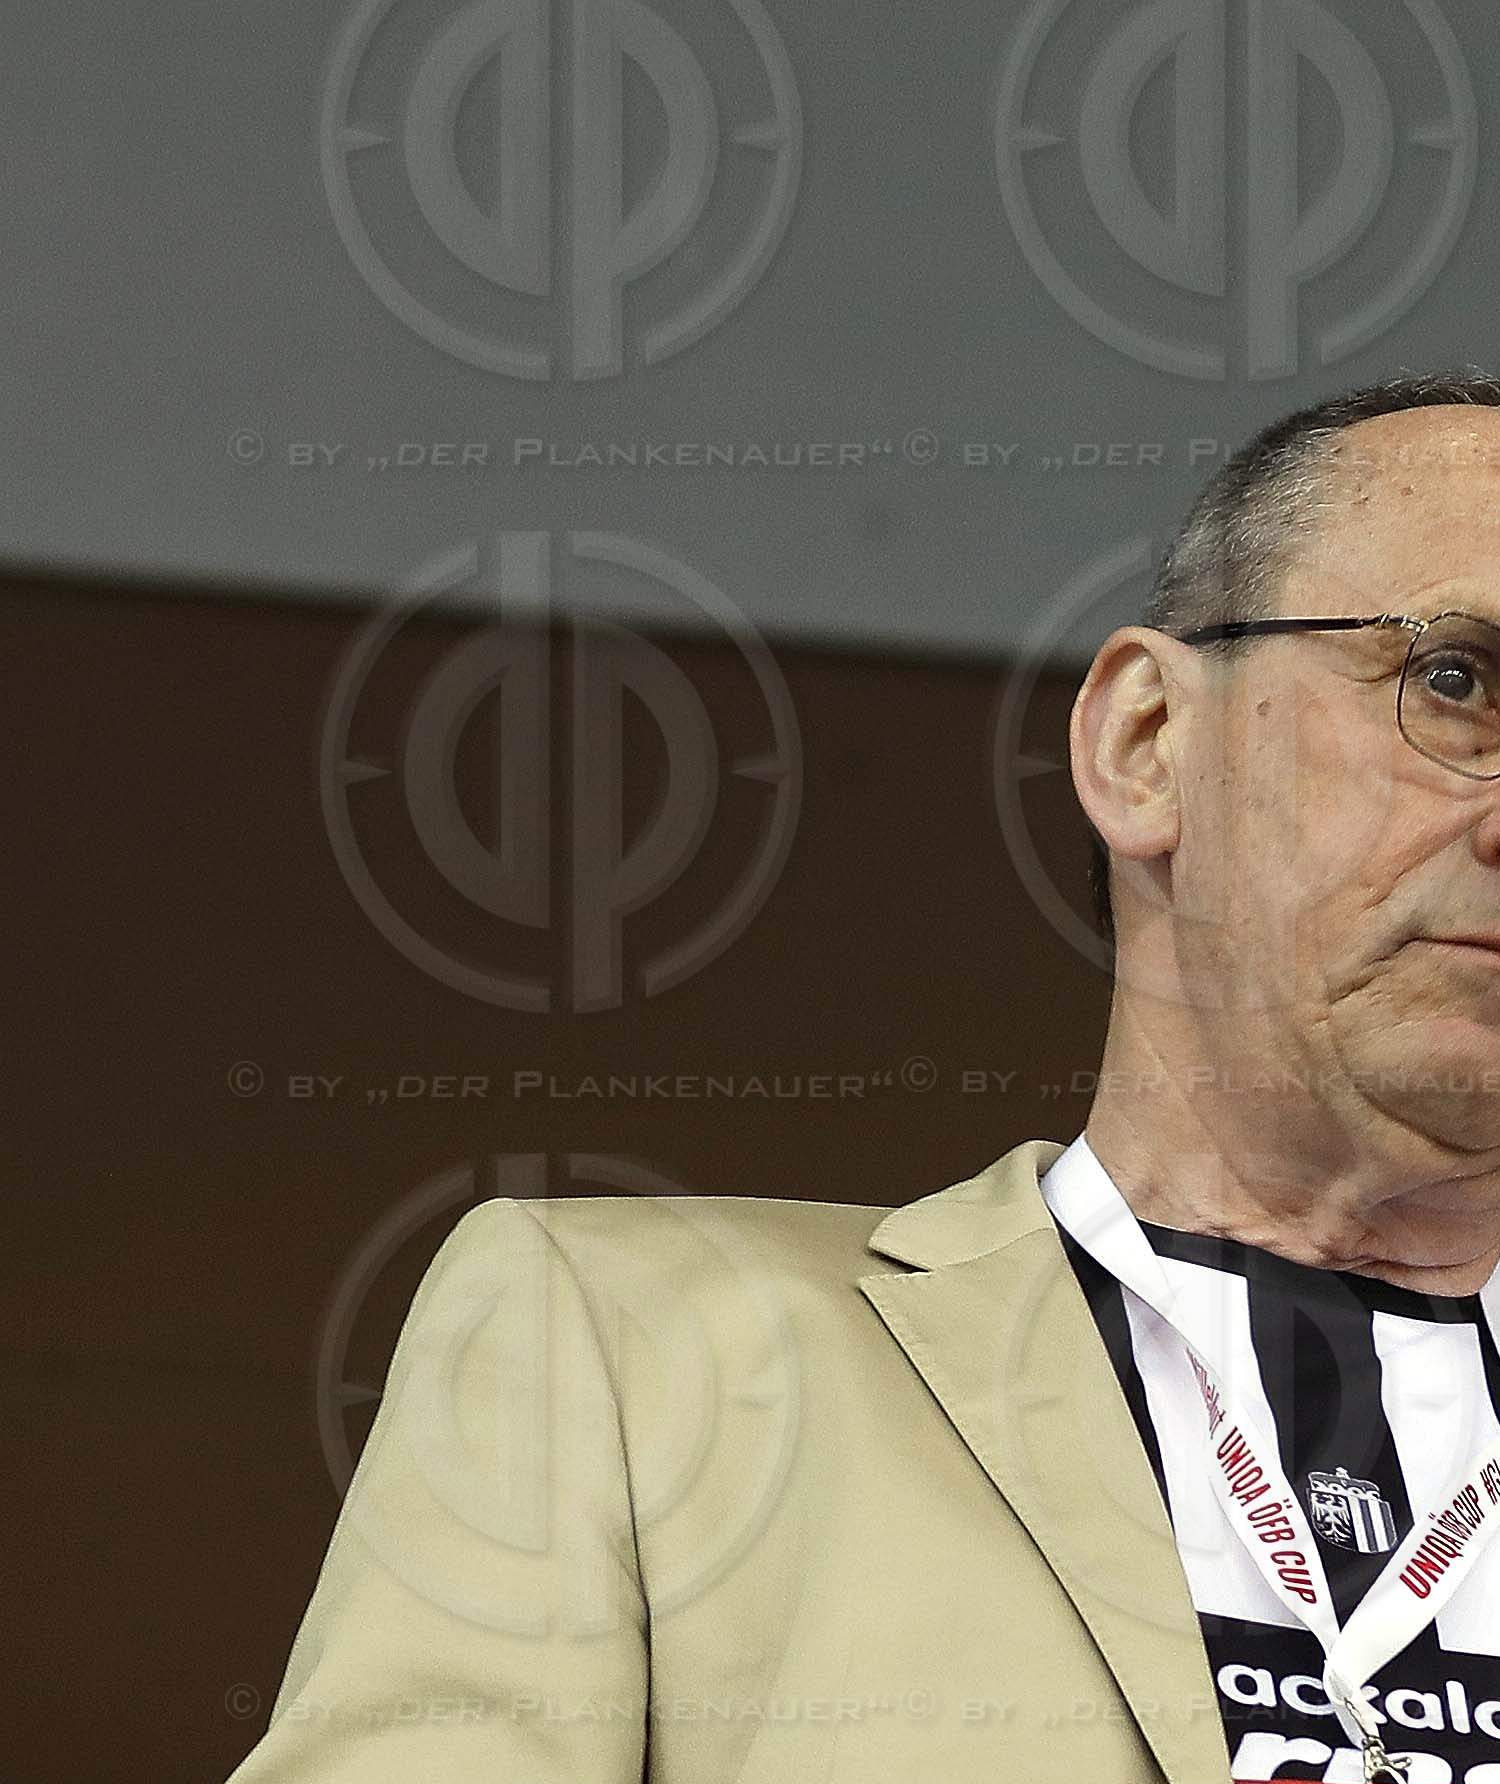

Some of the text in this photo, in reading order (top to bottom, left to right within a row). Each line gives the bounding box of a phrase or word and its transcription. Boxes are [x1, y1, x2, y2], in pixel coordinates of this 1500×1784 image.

[1215, 1424, 1318, 1605] UNIQA ÖFB CUP
[1399, 1526, 1466, 1600] UNIQA
[1451, 1483, 1486, 1531] CUP
